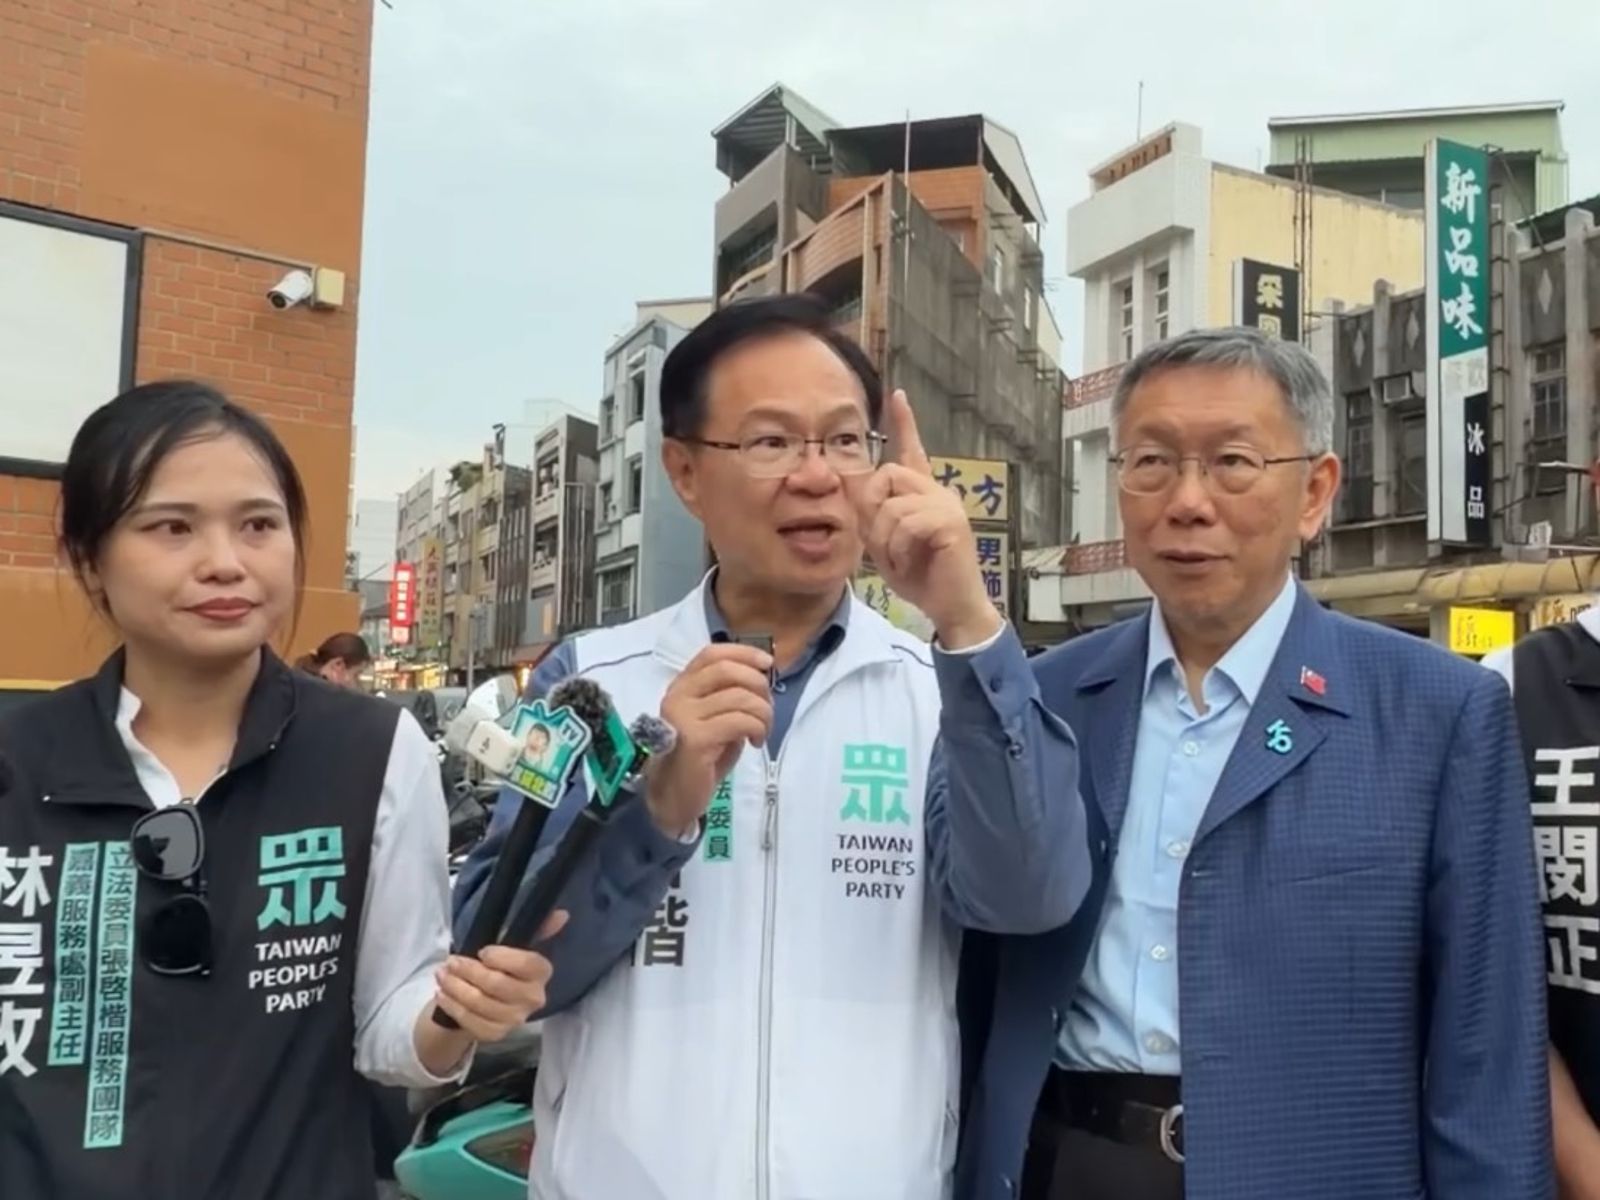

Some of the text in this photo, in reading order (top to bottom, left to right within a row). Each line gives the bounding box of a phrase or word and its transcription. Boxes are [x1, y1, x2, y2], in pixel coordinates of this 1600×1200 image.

[1440, 161, 1483, 341] 新品味
[1466, 422, 1485, 519] 冰品
[836, 834, 913, 853] TAIWAN
[831, 857, 915, 876] PEOPLE'S
[1530, 746, 1600, 994] 王閔正
[845, 881, 905, 900] PARTY
[53, 848, 98, 1059] 嘉義服務處副主任
[254, 933, 342, 962] TAIWAN
[265, 983, 326, 1014] PARTY
